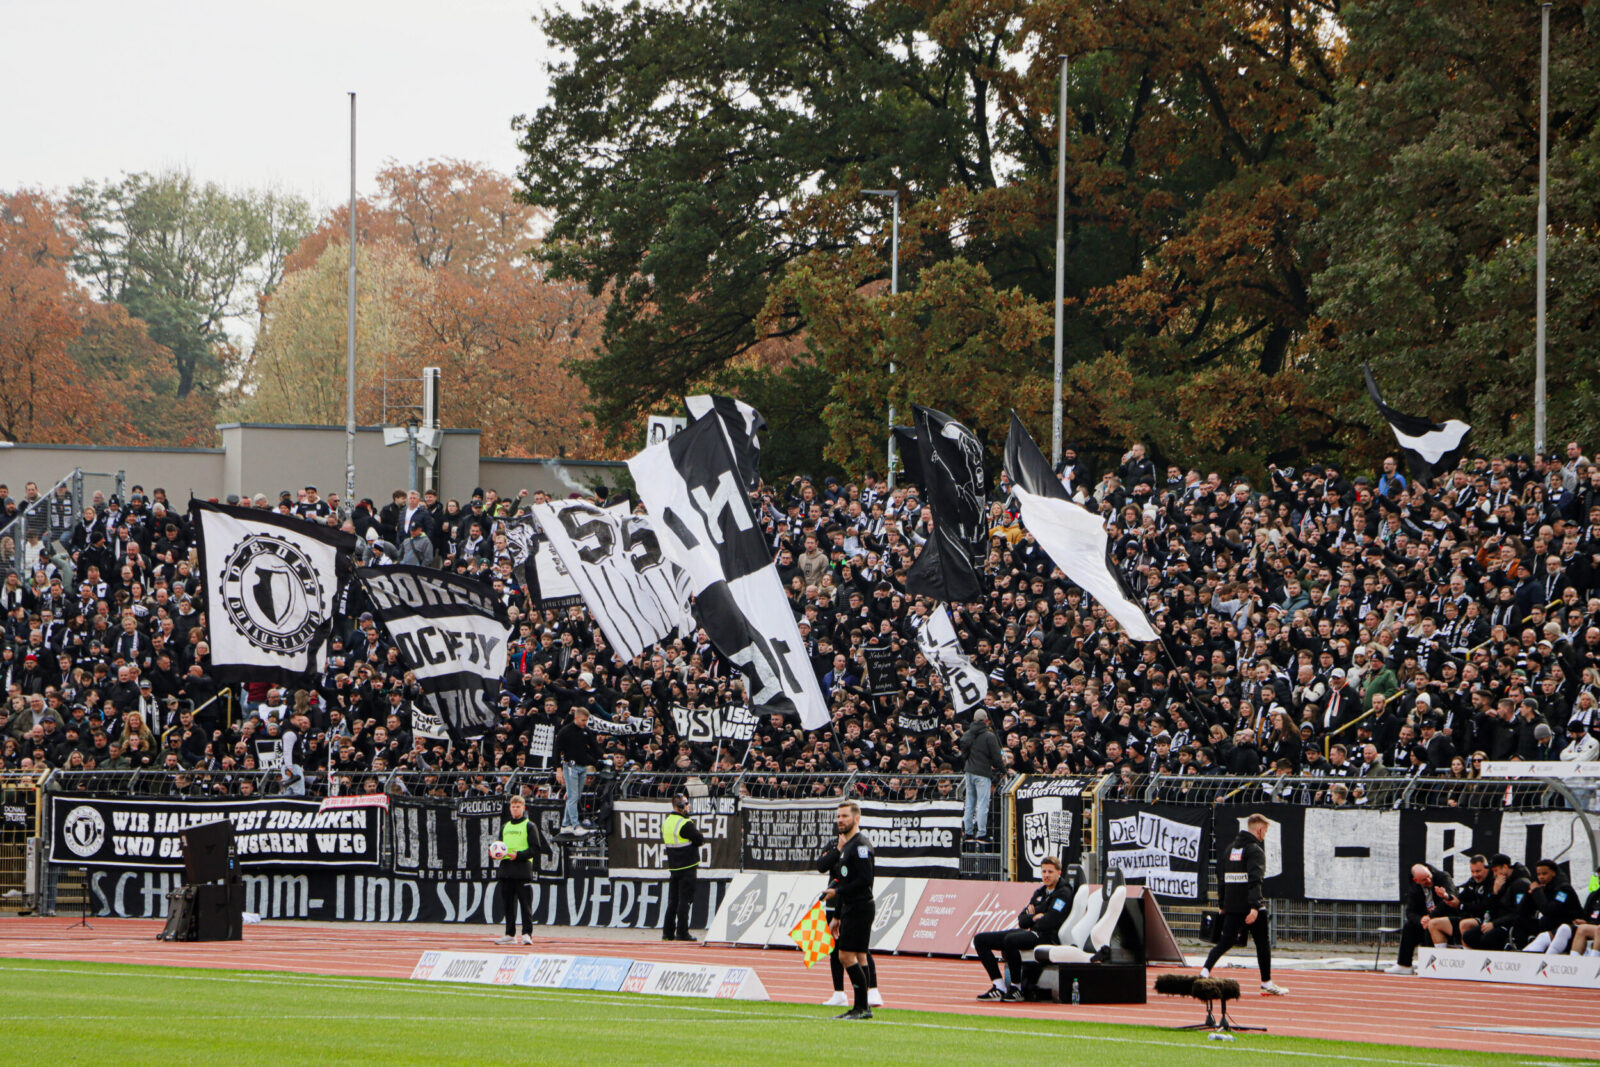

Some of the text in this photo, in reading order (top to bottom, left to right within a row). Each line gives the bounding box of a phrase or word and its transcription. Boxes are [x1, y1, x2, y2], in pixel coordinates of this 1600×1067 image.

[460, 800, 503, 814] PRODIGYS
[112, 811, 149, 832] WIR
[266, 810, 367, 829] ZUSAMMEN
[893, 816, 920, 828] nero
[1025, 813, 1047, 829] SSV
[1026, 825, 1048, 841] 1846
[1110, 820, 1136, 841] Die
[1140, 815, 1198, 859] Ultras
[112, 836, 154, 857] UND
[234, 833, 308, 855] NSEREN
[315, 834, 367, 854] WEG
[1109, 852, 1169, 869] gewinnen
[1148, 870, 1197, 897] immer
[442, 959, 488, 979] ADDITIVE
[655, 967, 716, 993] MOTORÖLE
